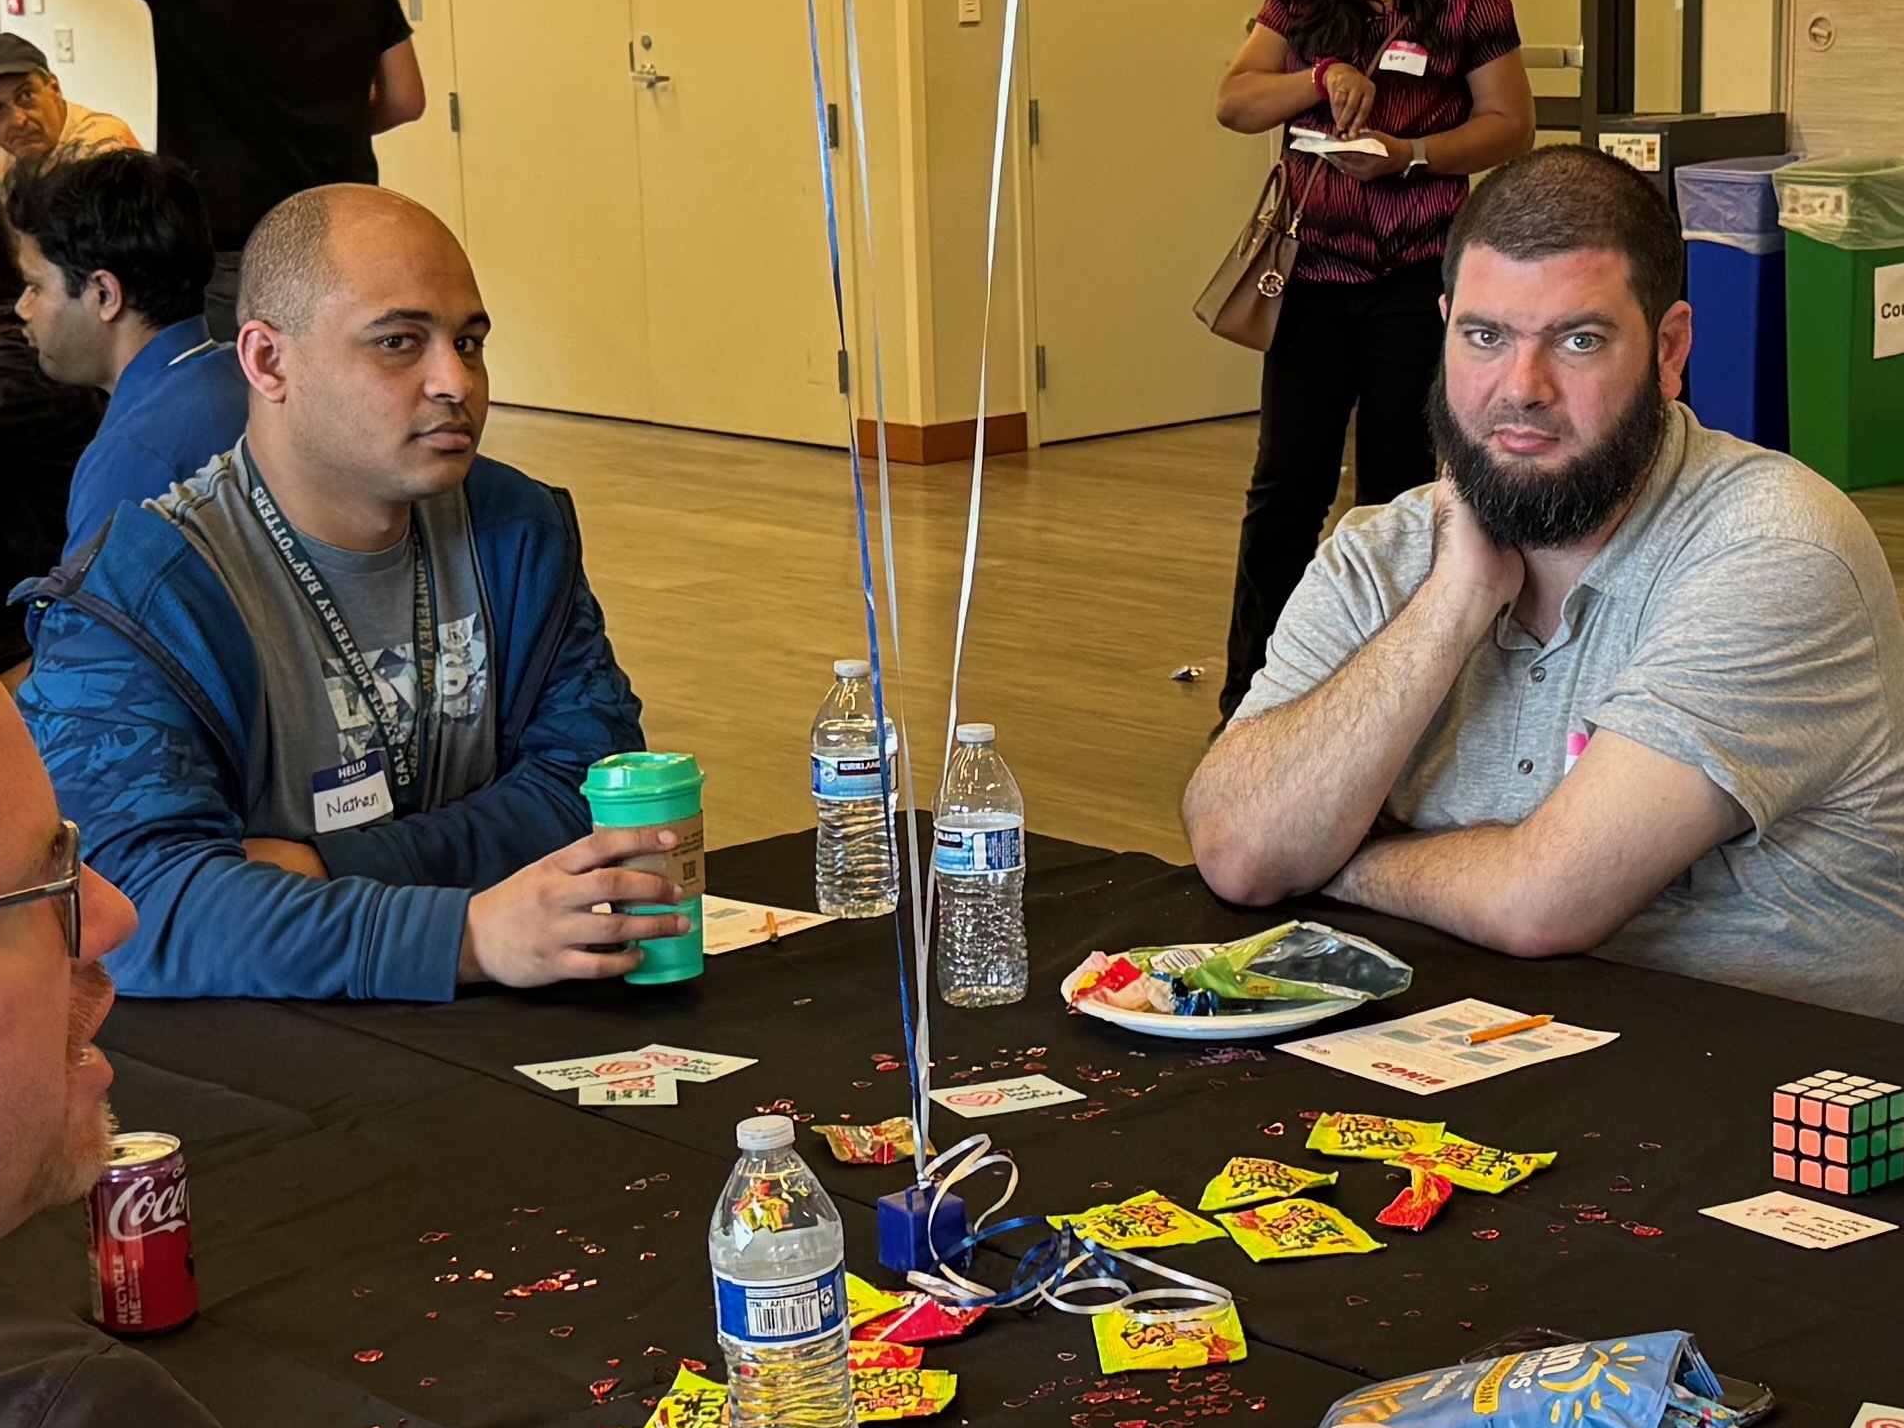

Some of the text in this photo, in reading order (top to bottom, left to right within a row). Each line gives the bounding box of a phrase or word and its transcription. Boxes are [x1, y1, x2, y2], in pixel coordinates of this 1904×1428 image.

[250, 485, 295, 552] OTTERS
[315, 598, 374, 688] MONTEREY
[337, 759, 368, 780] HELLO
[326, 792, 380, 818] Nathan
[112, 1254, 129, 1325] RECYCLE
[128, 1300, 142, 1325] ME
